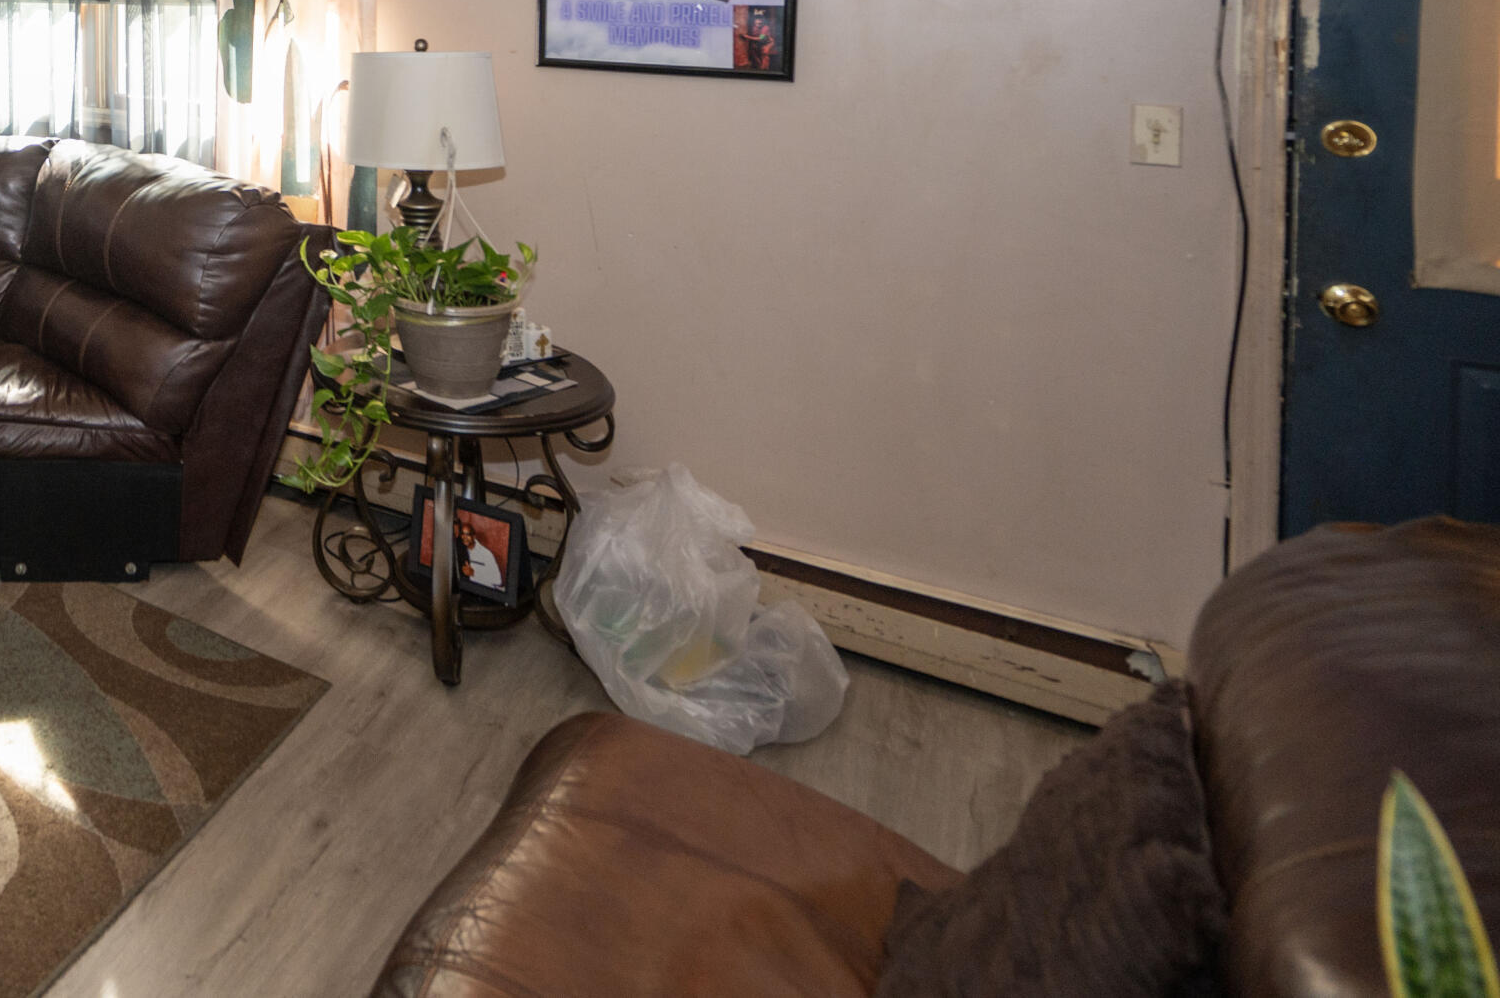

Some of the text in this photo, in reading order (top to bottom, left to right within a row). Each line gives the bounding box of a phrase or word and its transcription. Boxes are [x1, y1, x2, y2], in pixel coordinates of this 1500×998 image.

[577, 0, 624, 23] SMILE
[629, 2, 665, 25] AND
[669, 3, 733, 27] PRICELL
[609, 24, 700, 48] MEMORIES
